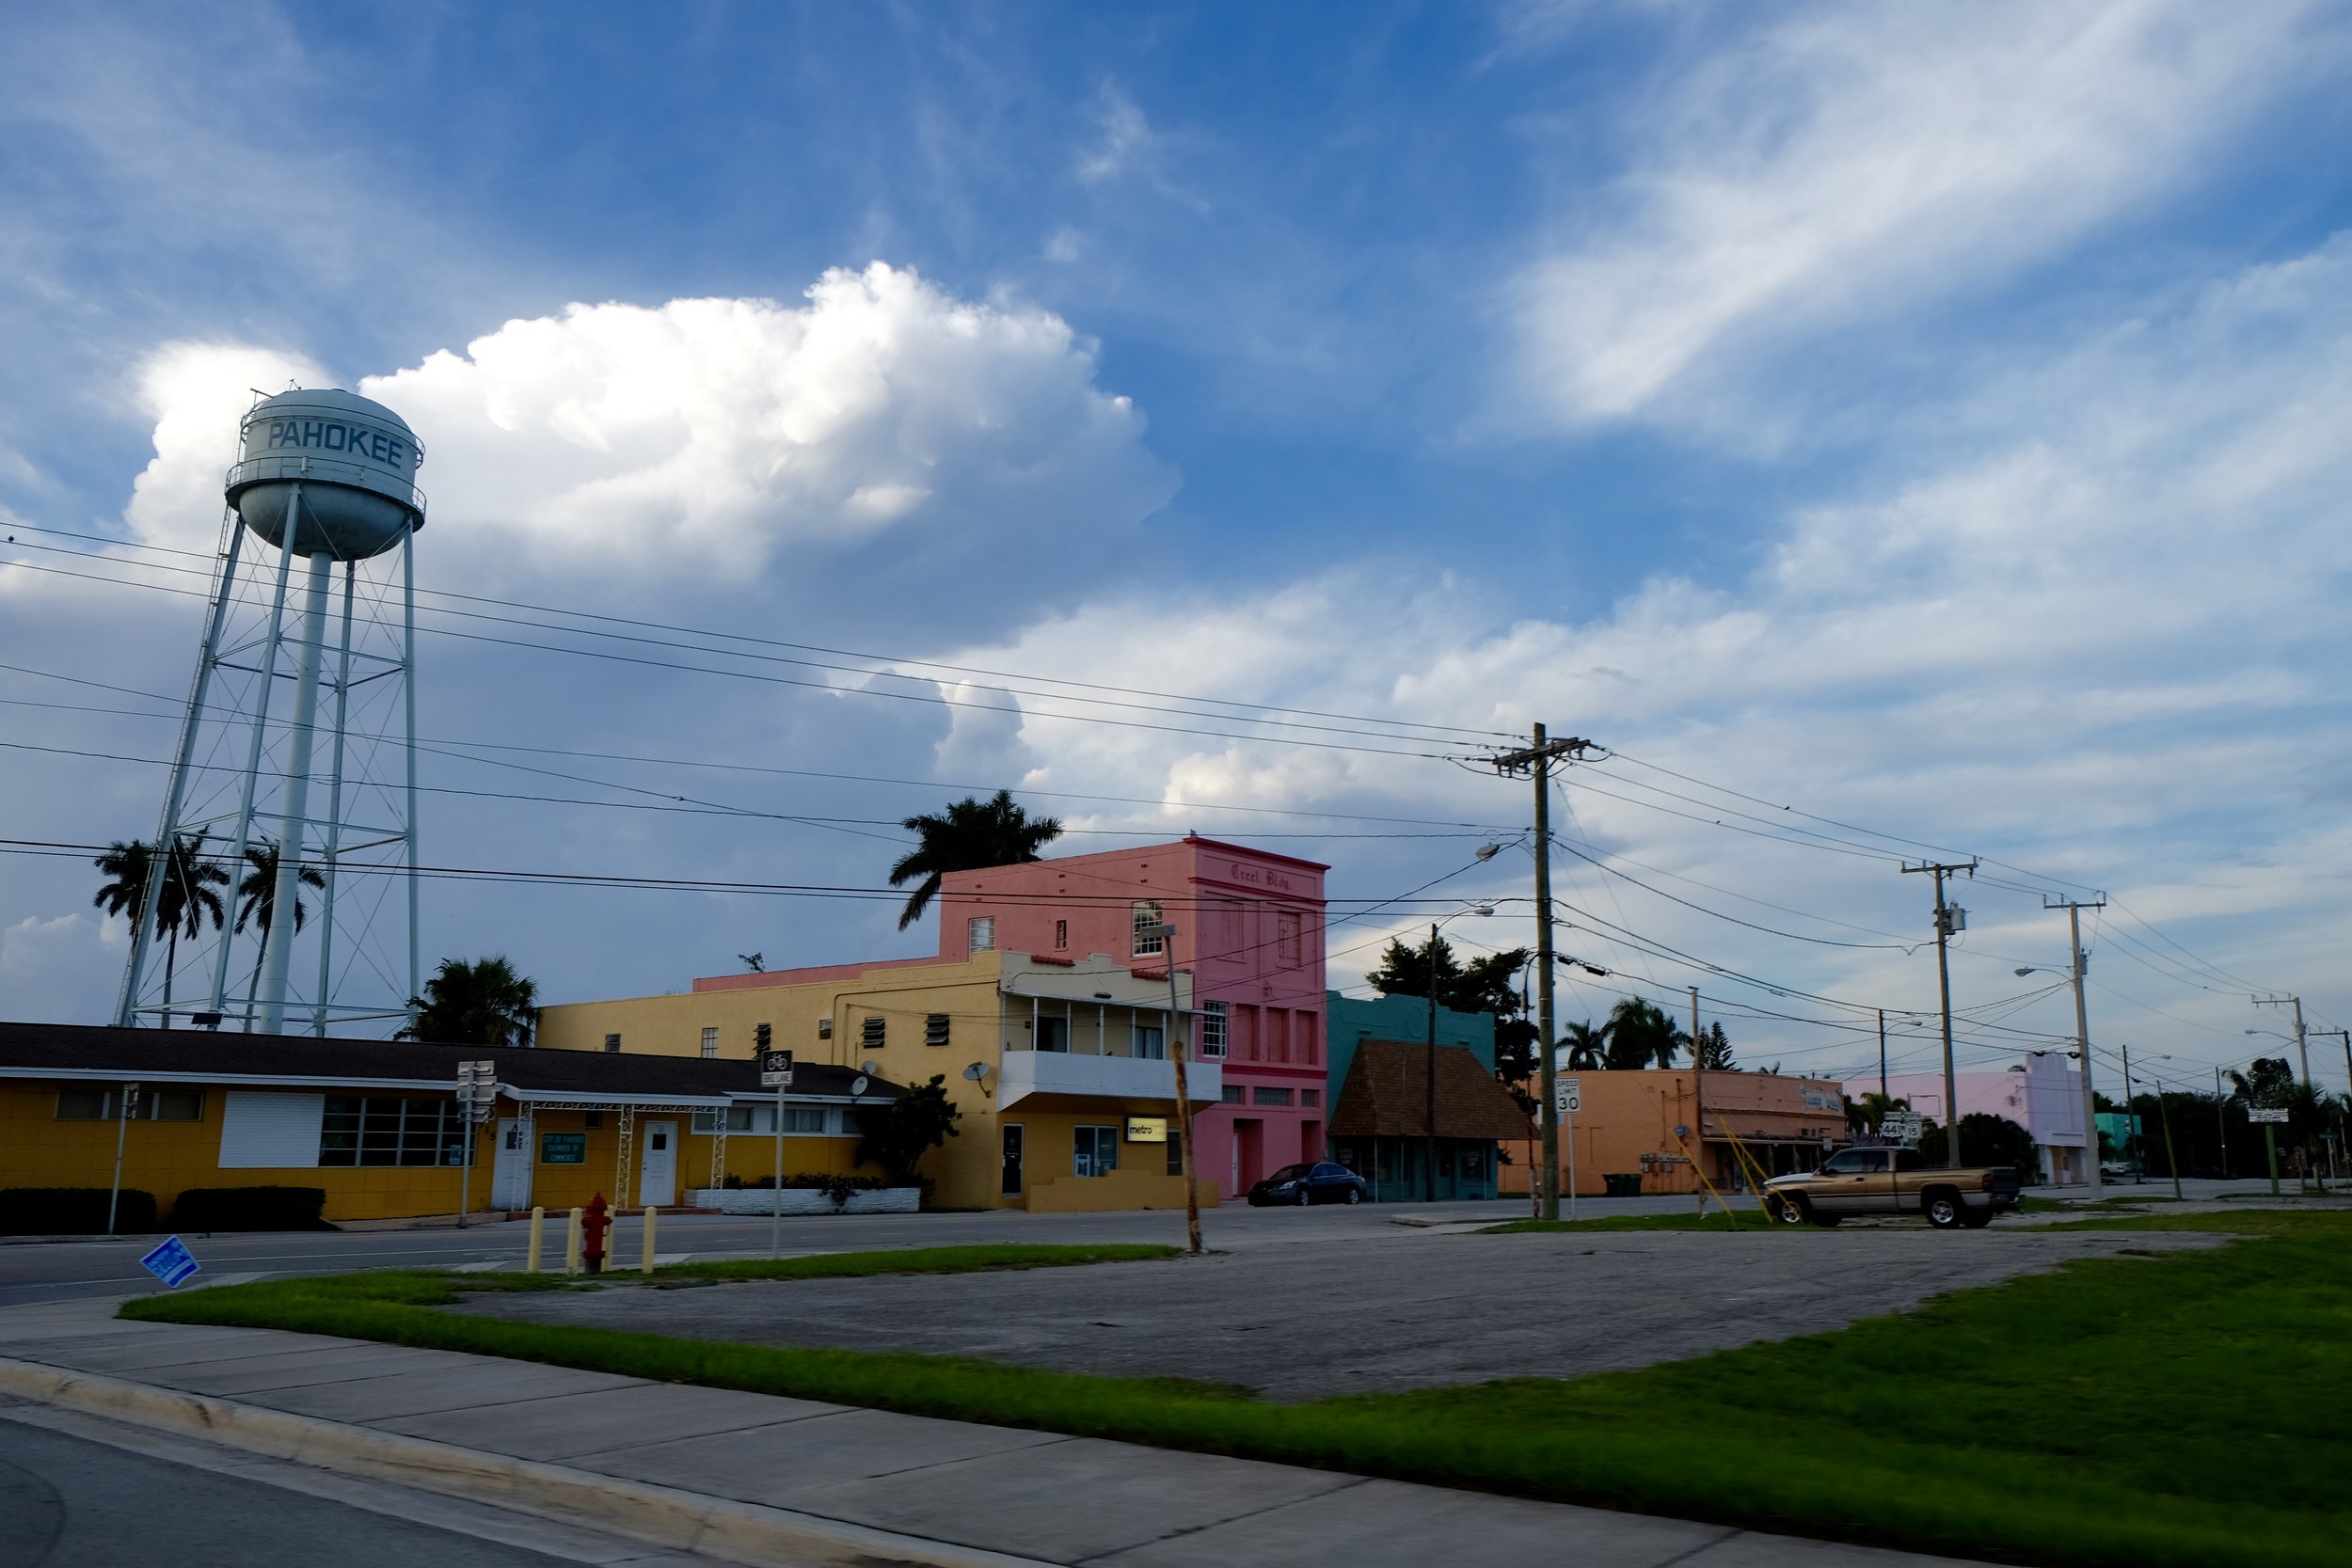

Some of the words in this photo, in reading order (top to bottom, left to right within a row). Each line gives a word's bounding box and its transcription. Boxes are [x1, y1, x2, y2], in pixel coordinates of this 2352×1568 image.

[268, 420, 403, 469] PAHOKEE
[1232, 863, 1260, 883] Creel
[764, 1073, 774, 1083] BIKE
[776, 1072, 790, 1083] LANE
[1558, 1097, 1579, 1110] 30
[1883, 1125, 1901, 1134] 441
[1908, 1128, 1917, 1136] 15
[548, 1144, 570, 1152] CHAMBER
